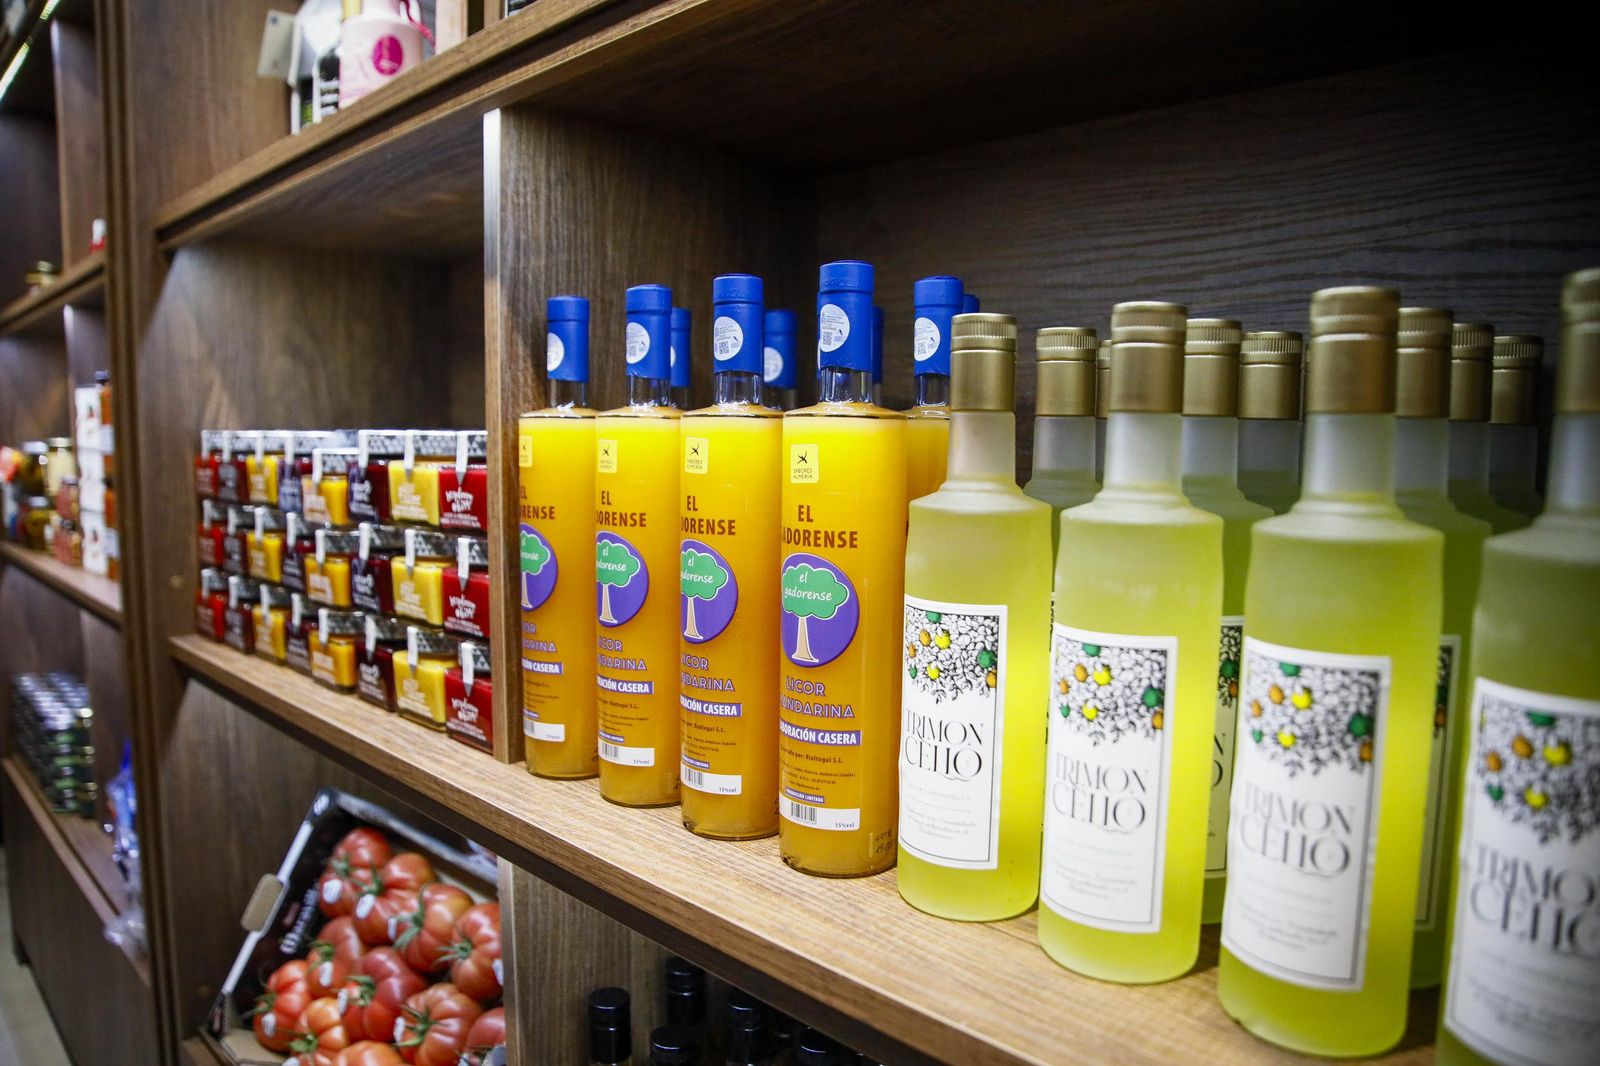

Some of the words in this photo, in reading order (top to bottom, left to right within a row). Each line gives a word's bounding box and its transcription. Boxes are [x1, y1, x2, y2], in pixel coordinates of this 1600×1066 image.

[601, 490, 612, 505] EL
[686, 495, 698, 512] EL
[520, 504, 555, 520] RENSE
[798, 504, 814, 523] EL
[687, 556, 695, 568] el
[799, 571, 808, 583] el
[784, 585, 833, 601] gadorense
[533, 661, 560, 673] CASERA
[617, 682, 650, 694] CASERA
[786, 675, 826, 697] LICOR
[703, 703, 738, 716] CASERA
[817, 732, 858, 745] CASERA
